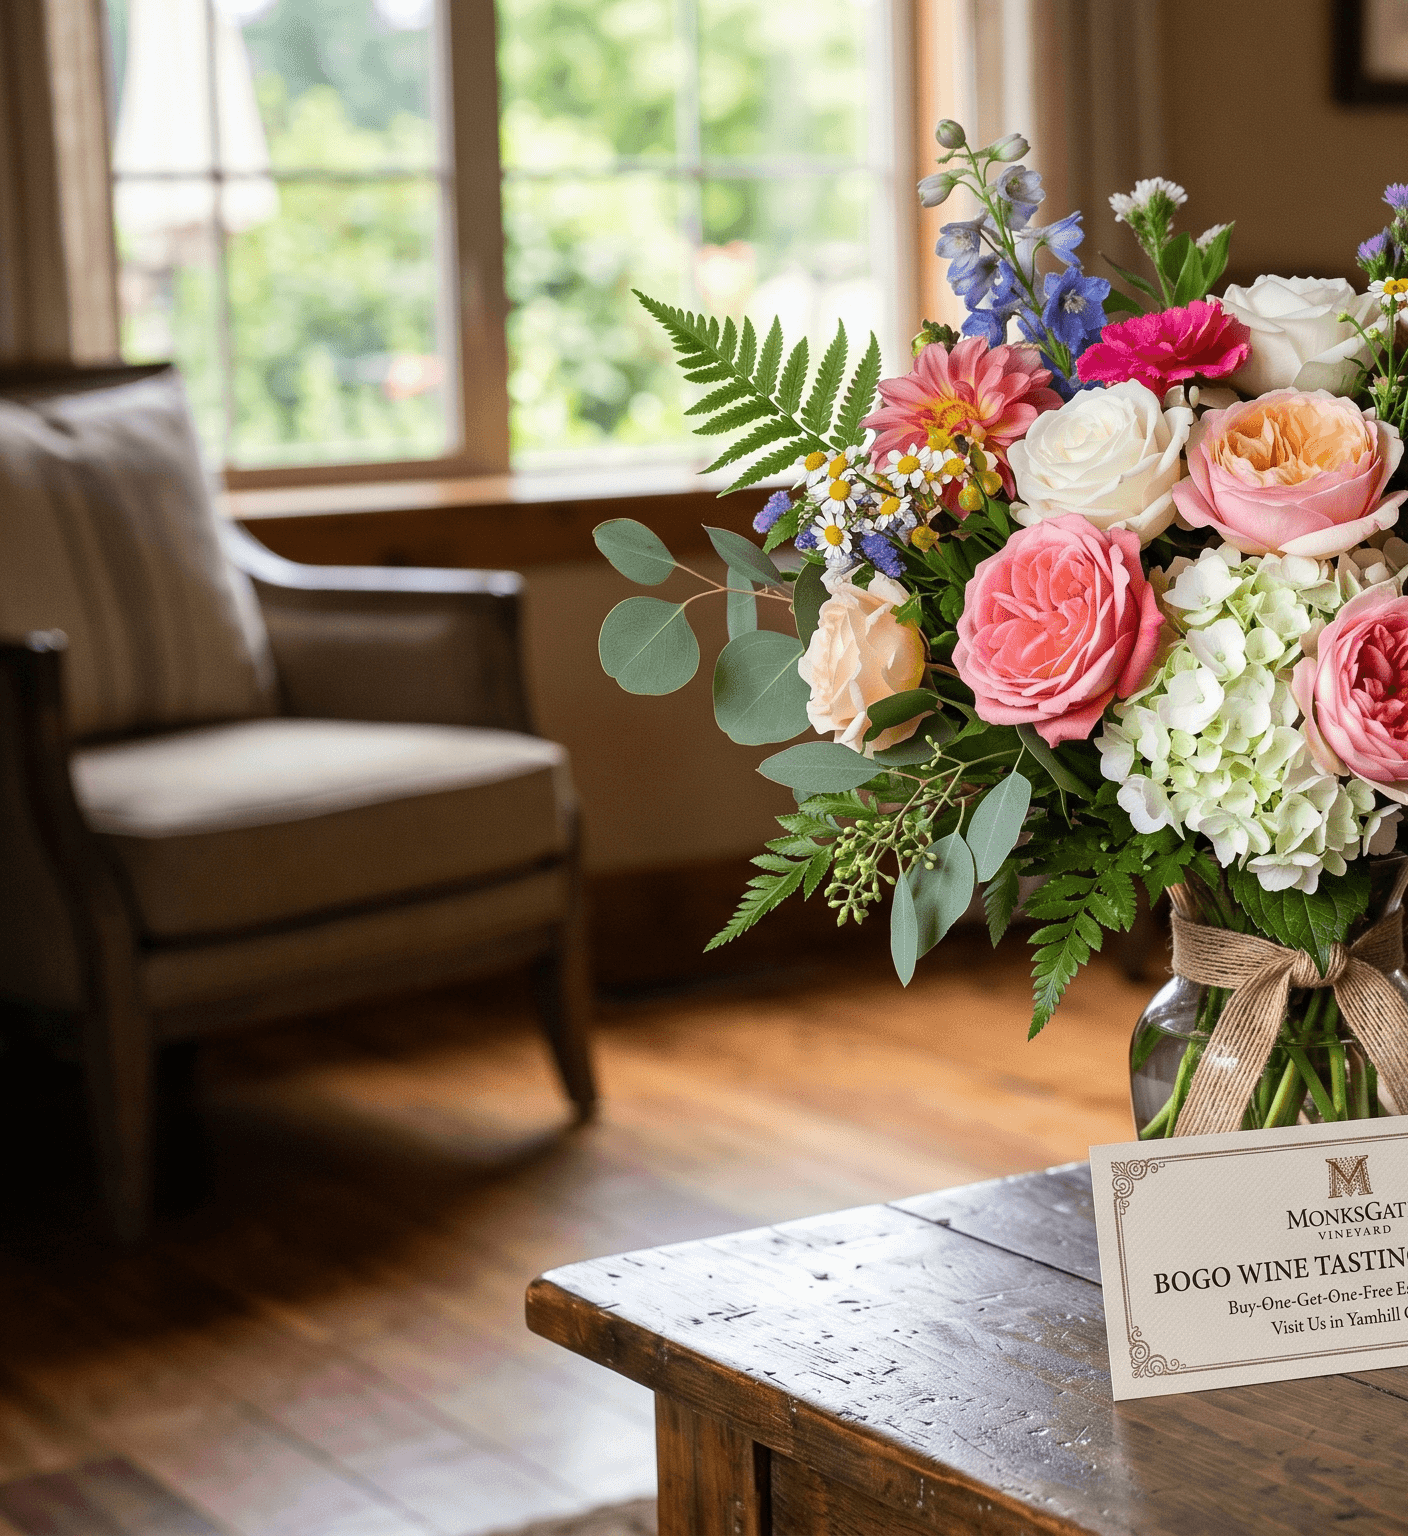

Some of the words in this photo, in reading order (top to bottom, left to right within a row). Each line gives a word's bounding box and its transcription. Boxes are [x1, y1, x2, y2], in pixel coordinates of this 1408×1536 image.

[1325, 1154, 1374, 1199] M
[1318, 1224, 1392, 1240] VINEYARD
[1153, 1266, 1231, 1295] BOGO
[1237, 1257, 1309, 1285] WINE
[1228, 1286, 1393, 1317] Buy-One-Get-One-Free
[1271, 1317, 1305, 1335] Visit
[1307, 1316, 1327, 1331] Us
[1330, 1315, 1344, 1329] in
[1346, 1306, 1401, 1327] Yamhill
